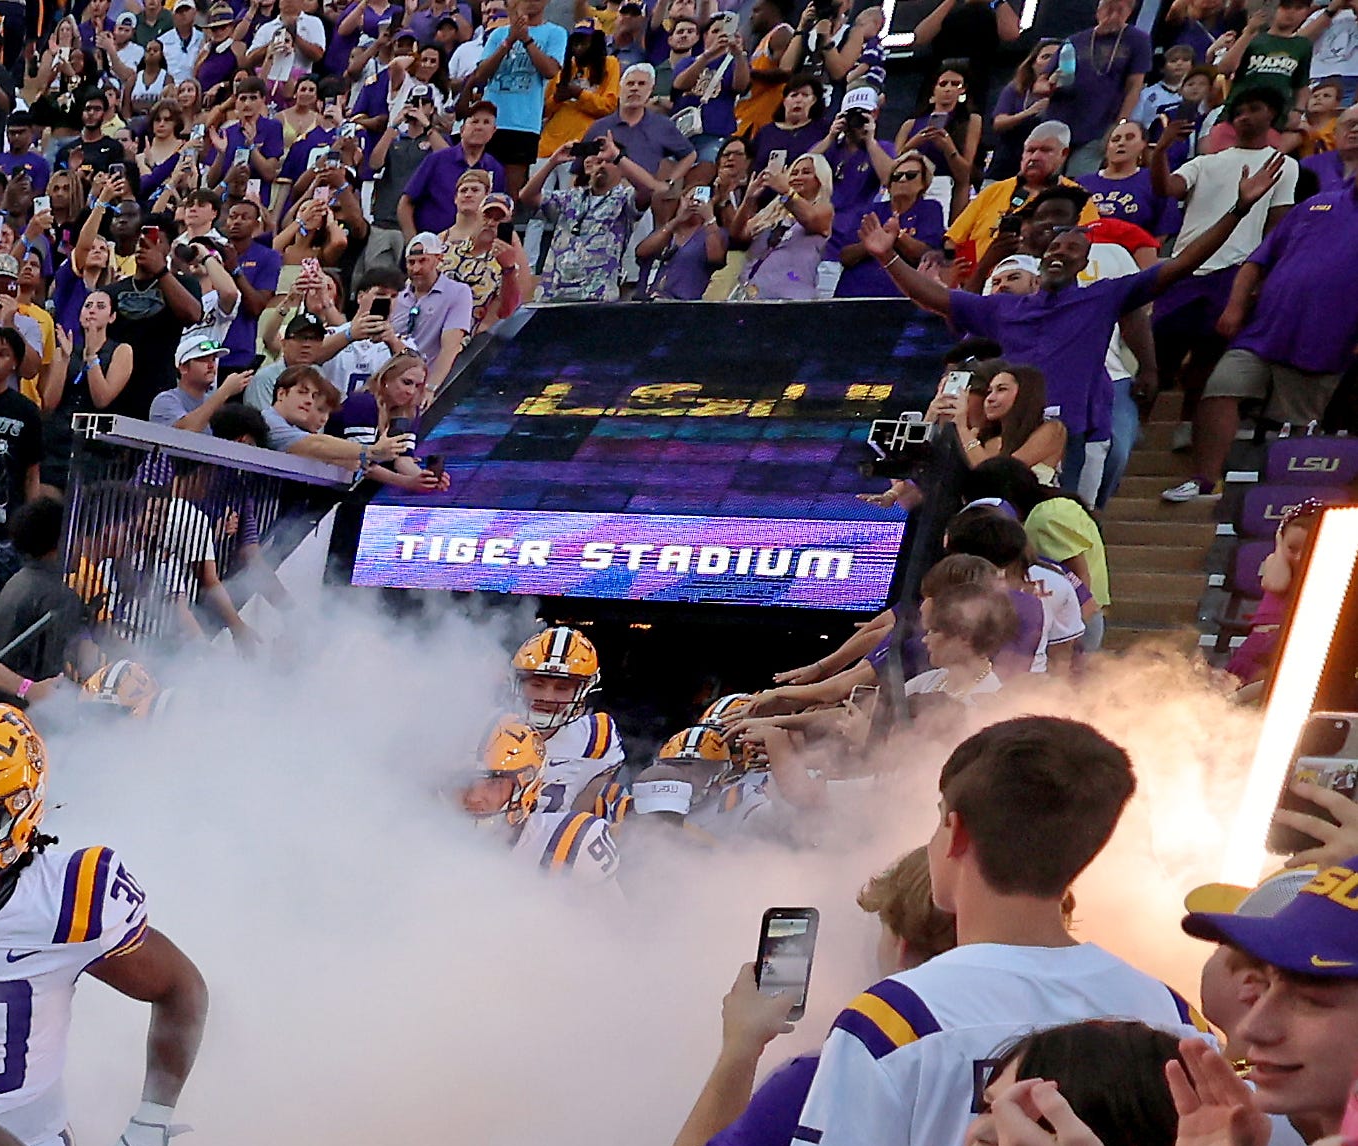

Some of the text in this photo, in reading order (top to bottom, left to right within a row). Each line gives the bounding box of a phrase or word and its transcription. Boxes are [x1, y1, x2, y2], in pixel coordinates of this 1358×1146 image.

[1287, 457, 1340, 472] LSU
[1263, 504, 1302, 521] LS
[396, 534, 854, 583] TIGER STADIUM
